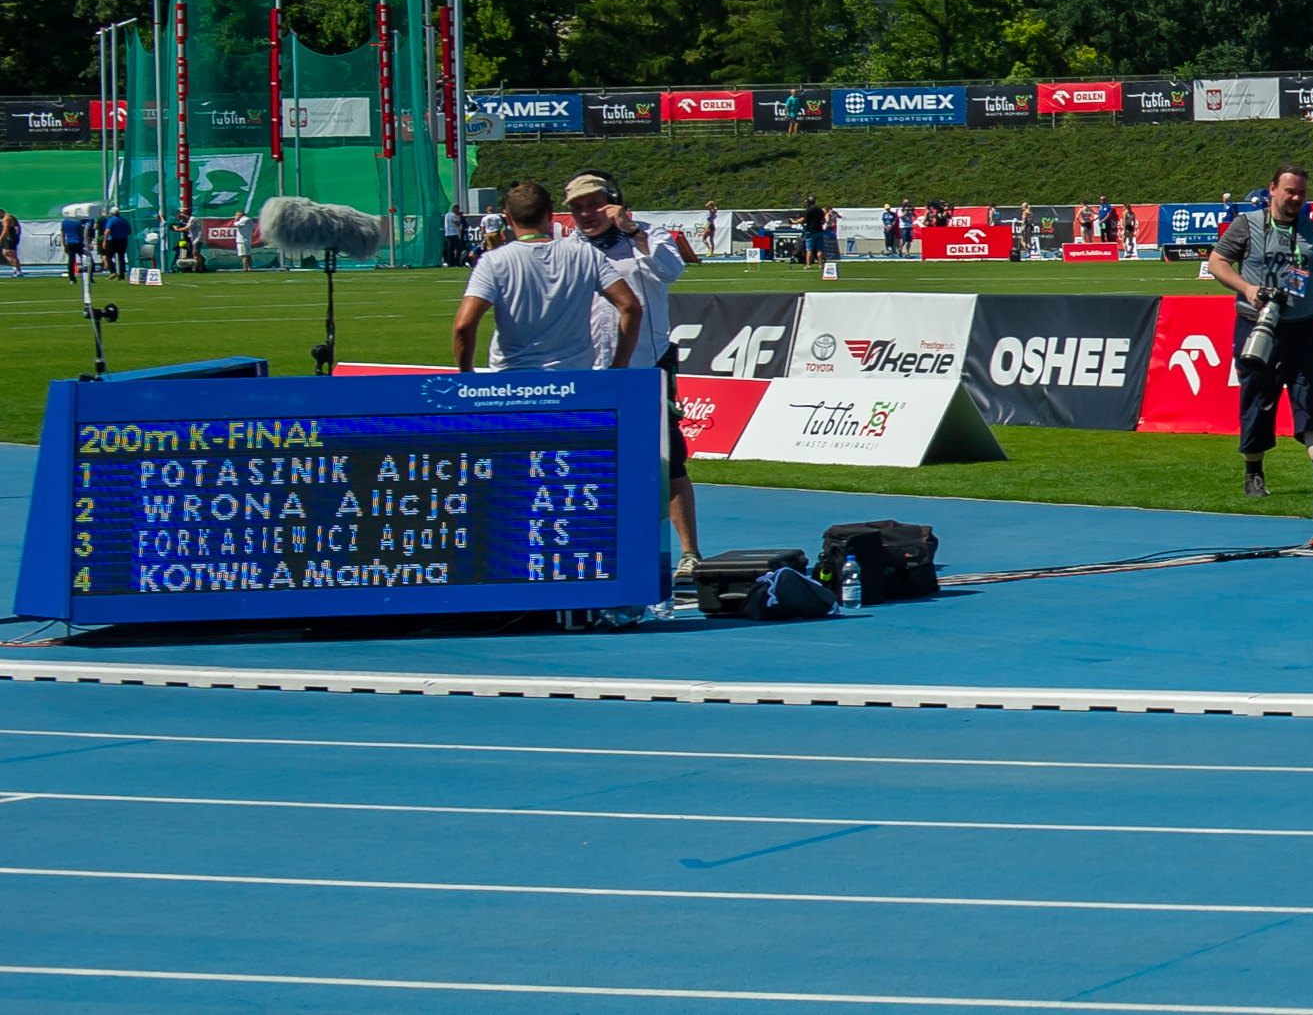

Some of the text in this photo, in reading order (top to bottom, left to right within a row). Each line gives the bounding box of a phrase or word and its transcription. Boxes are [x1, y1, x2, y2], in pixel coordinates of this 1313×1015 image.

[703, 100, 733, 109] ORLEN
[867, 93, 955, 111] TAMEX
[1075, 92, 1104, 102] ORLEN
[482, 100, 570, 117] TAMEX
[736, 220, 754, 231] 4F
[763, 220, 782, 231] 4F
[847, 240, 855, 253] 7
[949, 245, 986, 254] ORLEN
[710, 324, 786, 378] 4F
[860, 337, 955, 378] Okęcie
[805, 362, 835, 373] TOYOTA
[990, 336, 1131, 387] OSHEE
[457, 382, 576, 398] domtel-sport.pl
[79, 424, 179, 453] 200m
[794, 440, 879, 451] MIASTO INSPIRACJI
[79, 450, 571, 489] 1 POTASZNIK Alicja KS
[75, 484, 599, 523] 2 WRONA Alicja AZS
[74, 518, 570, 558] 3 FORKASIEWICZ Agata KS
[74, 551, 610, 592] 4 KOTWIŁA Martyna RLTL
